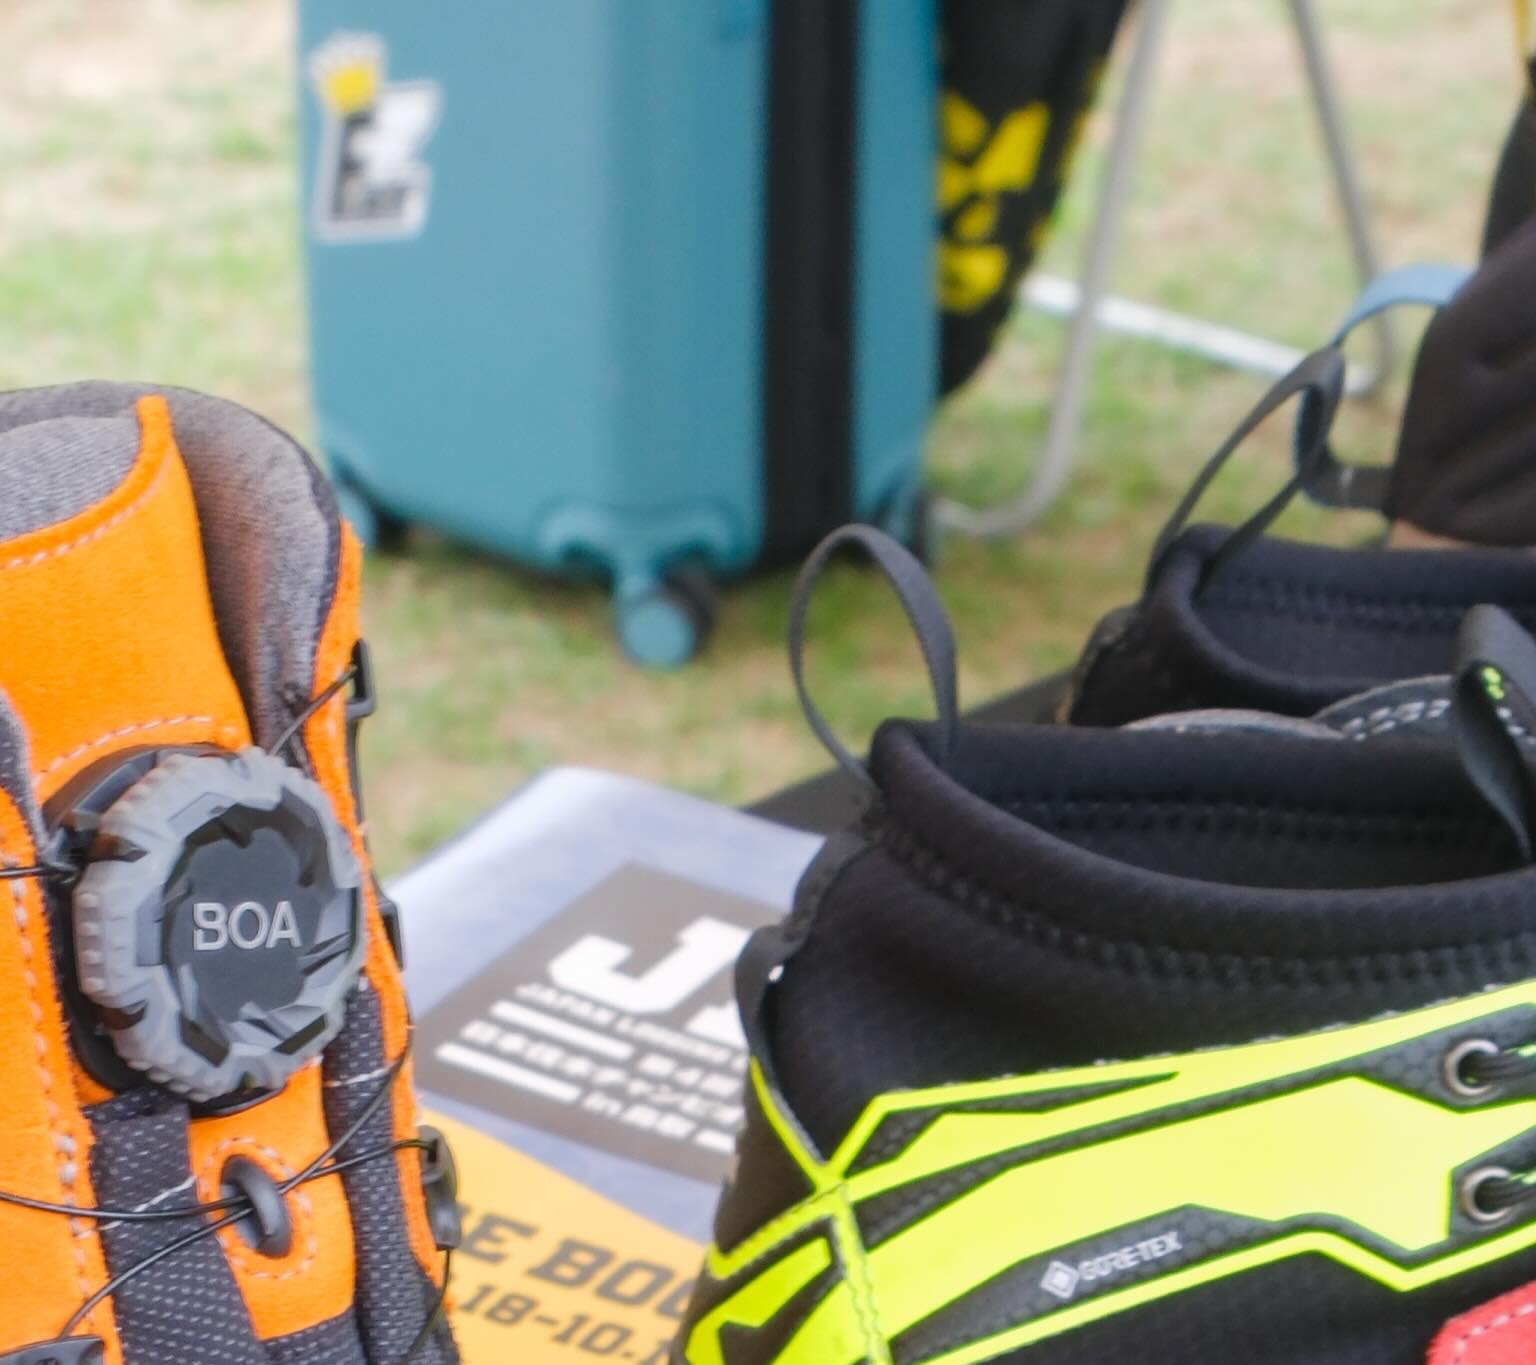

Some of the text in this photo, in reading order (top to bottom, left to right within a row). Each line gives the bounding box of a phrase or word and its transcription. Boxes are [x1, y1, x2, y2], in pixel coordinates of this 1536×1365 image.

[193, 901, 302, 951] BOA
[454, 1202, 539, 1264] E
[1077, 1231, 1183, 1281] GORE-TEX
